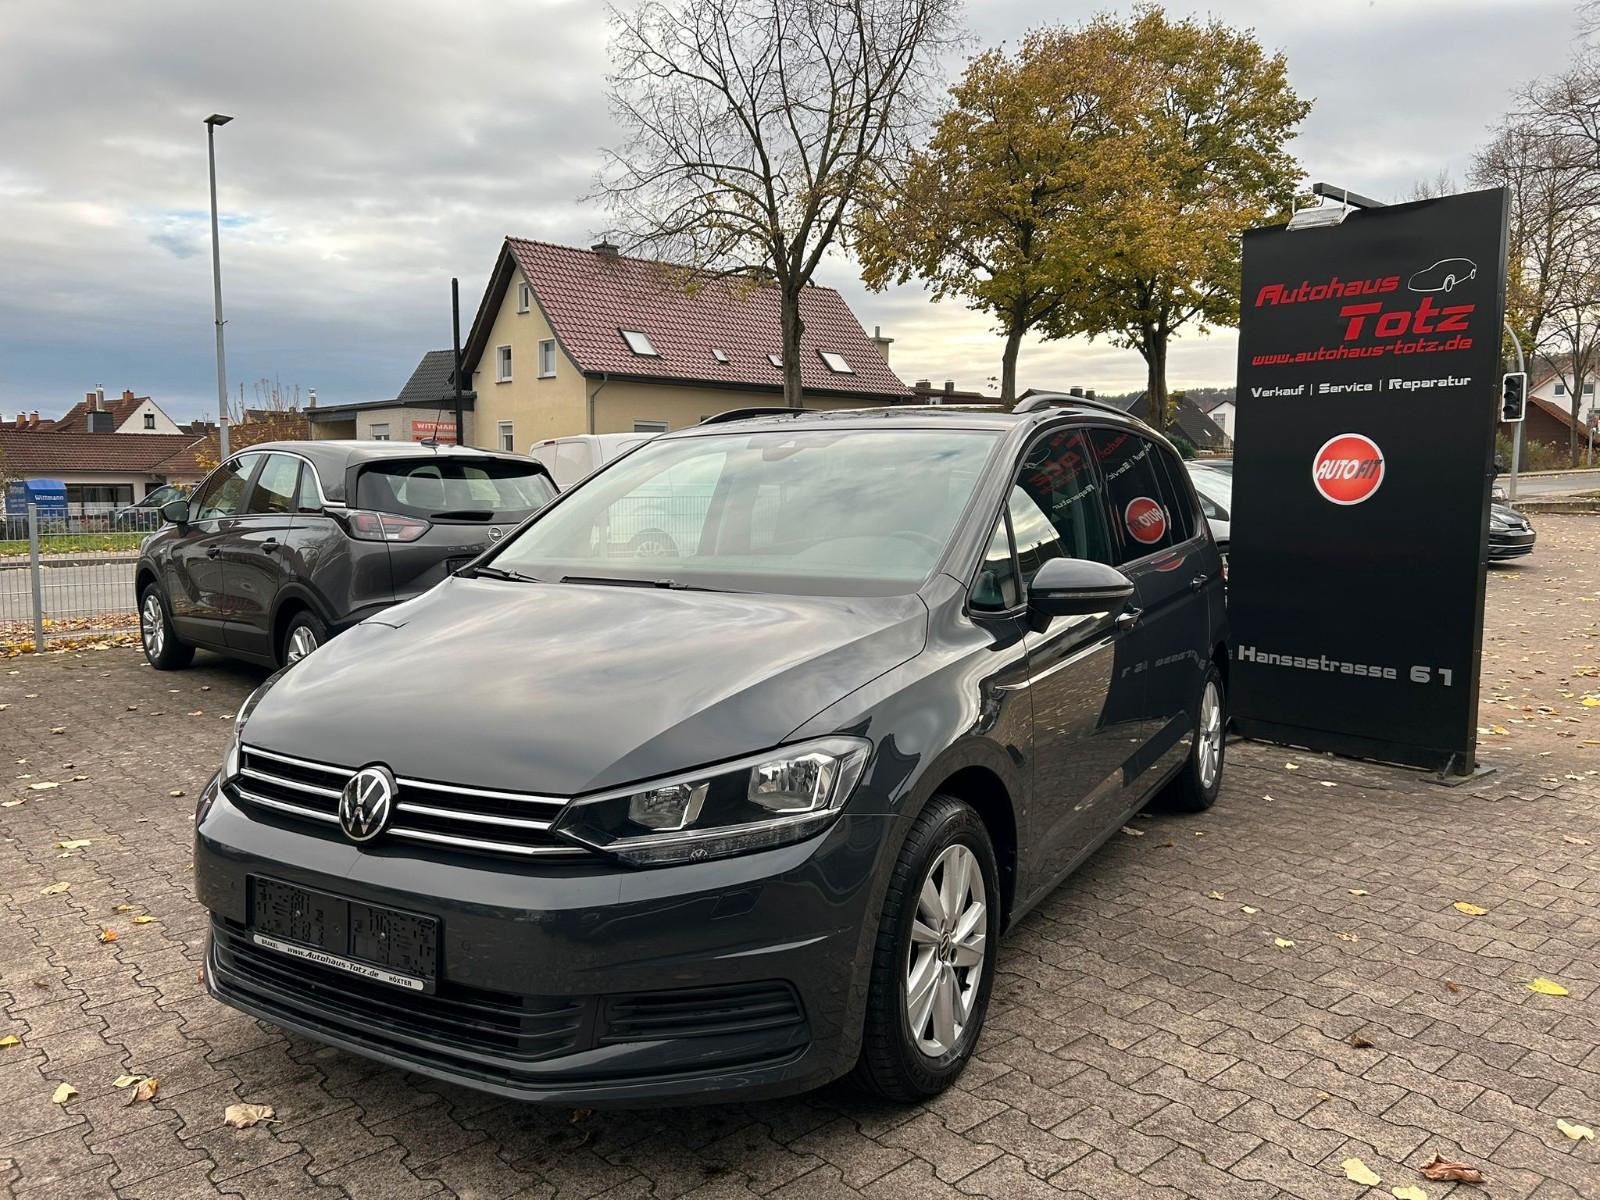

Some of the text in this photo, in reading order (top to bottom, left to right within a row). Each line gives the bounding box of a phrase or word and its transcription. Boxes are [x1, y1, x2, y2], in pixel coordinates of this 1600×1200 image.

[1255, 275, 1400, 307] Autohaus
[1340, 296, 1475, 341] Totz
[1252, 335, 1473, 366] www.autohaus-totz.de
[1251, 376, 1471, 398] Verkauf Service Reparatur
[1316, 458, 1382, 480] AUTOFIT
[1238, 645, 1397, 680] Hansastrasse
